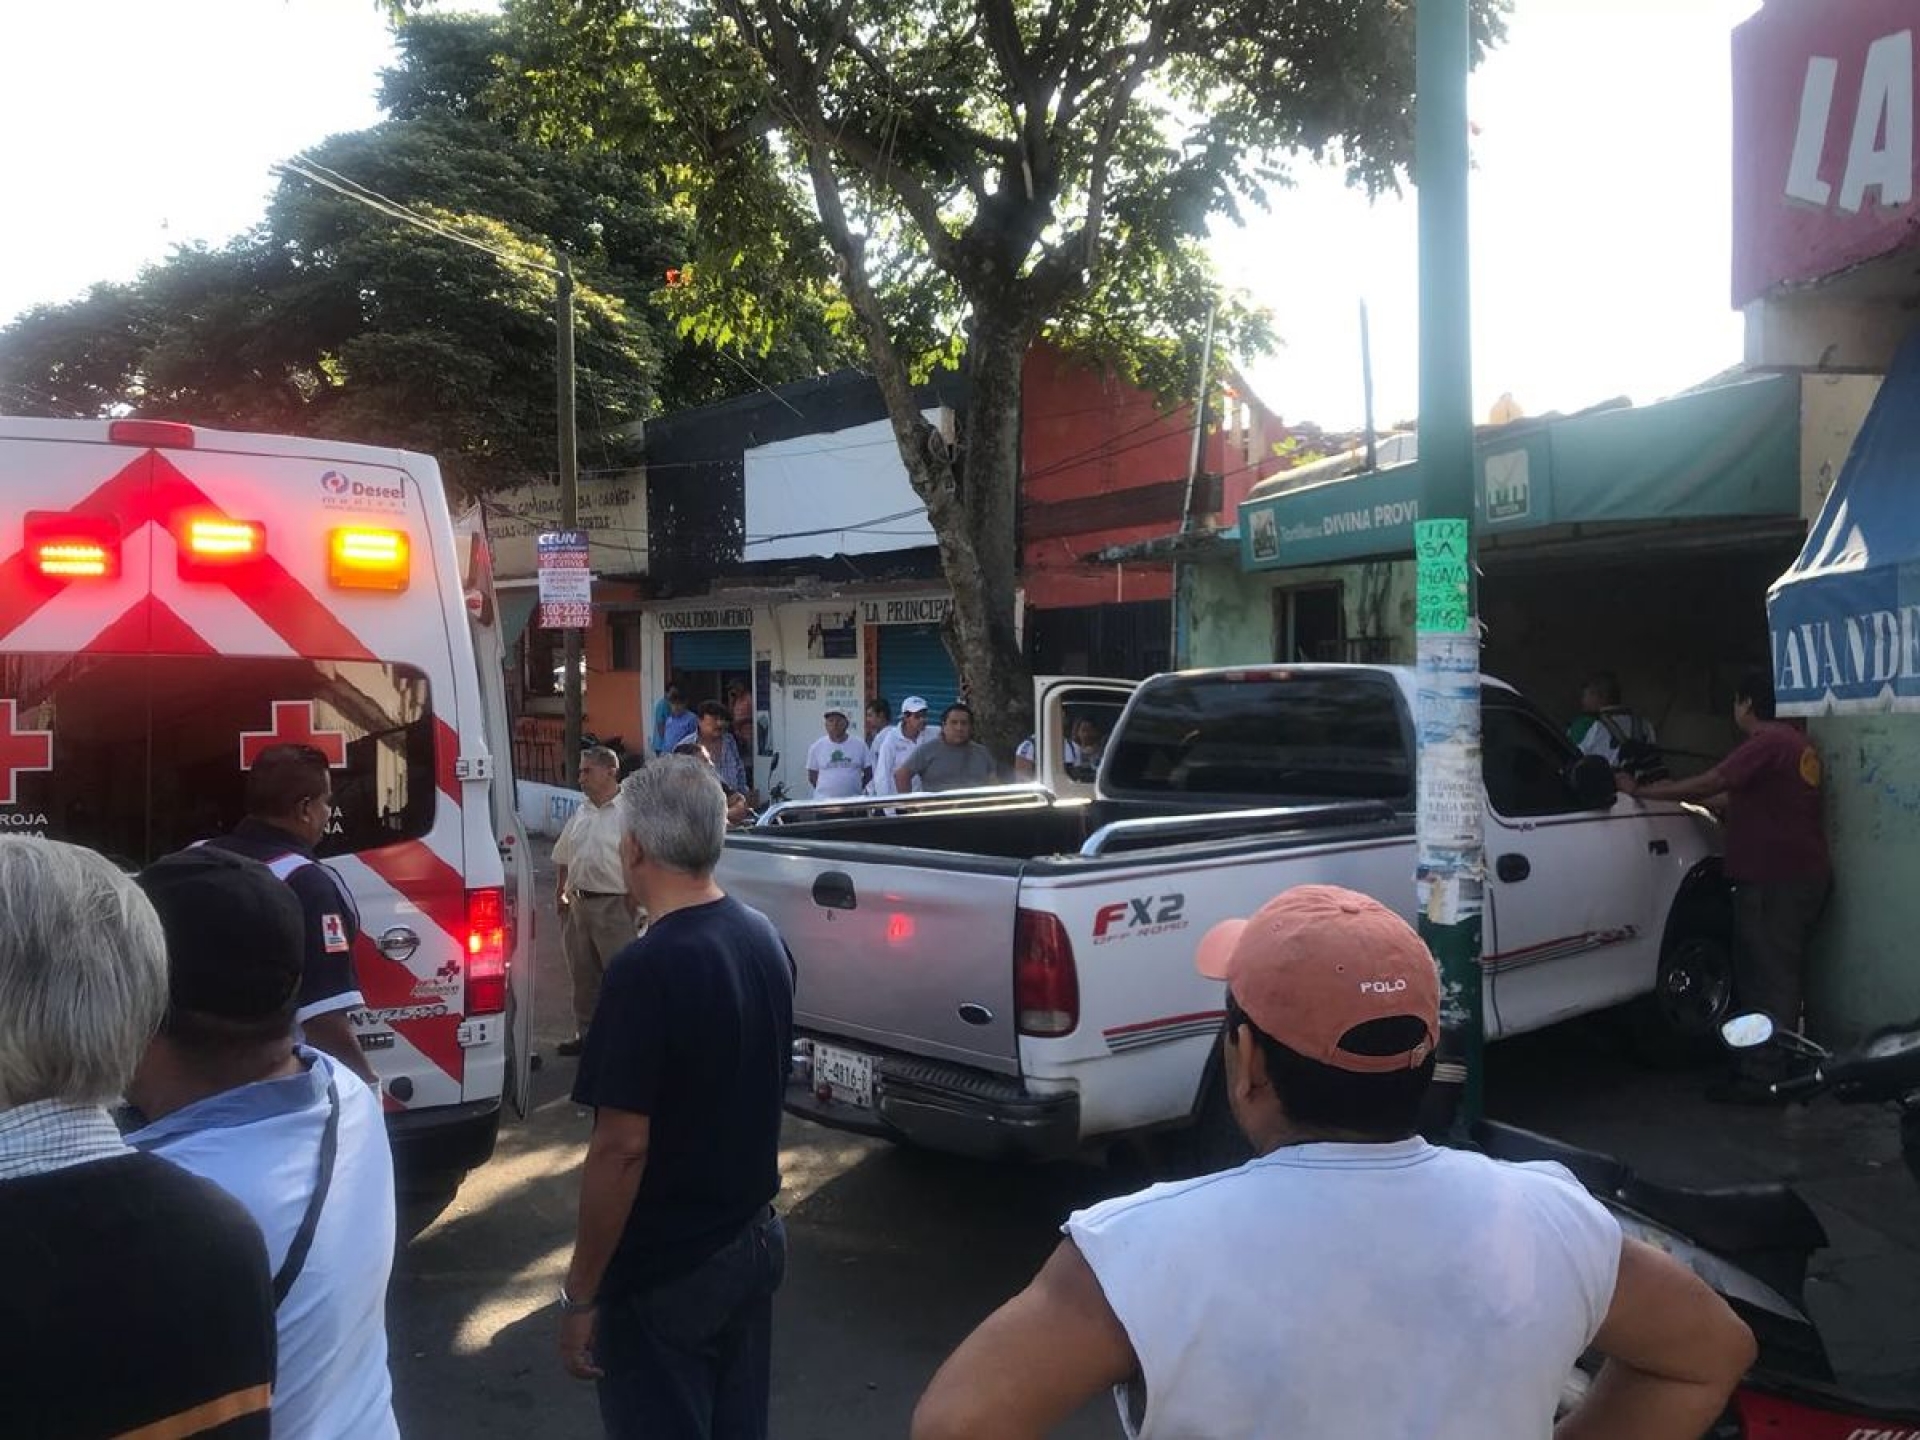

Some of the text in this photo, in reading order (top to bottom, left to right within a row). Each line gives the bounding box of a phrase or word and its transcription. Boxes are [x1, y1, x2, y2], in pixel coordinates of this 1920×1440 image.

[1785, 29, 1912, 214] LA
[1323, 511, 1371, 536] DIVINA
[0, 812, 49, 826] ROJA
[1093, 893, 1184, 937] FX2
[1360, 978, 1406, 993] POLO
